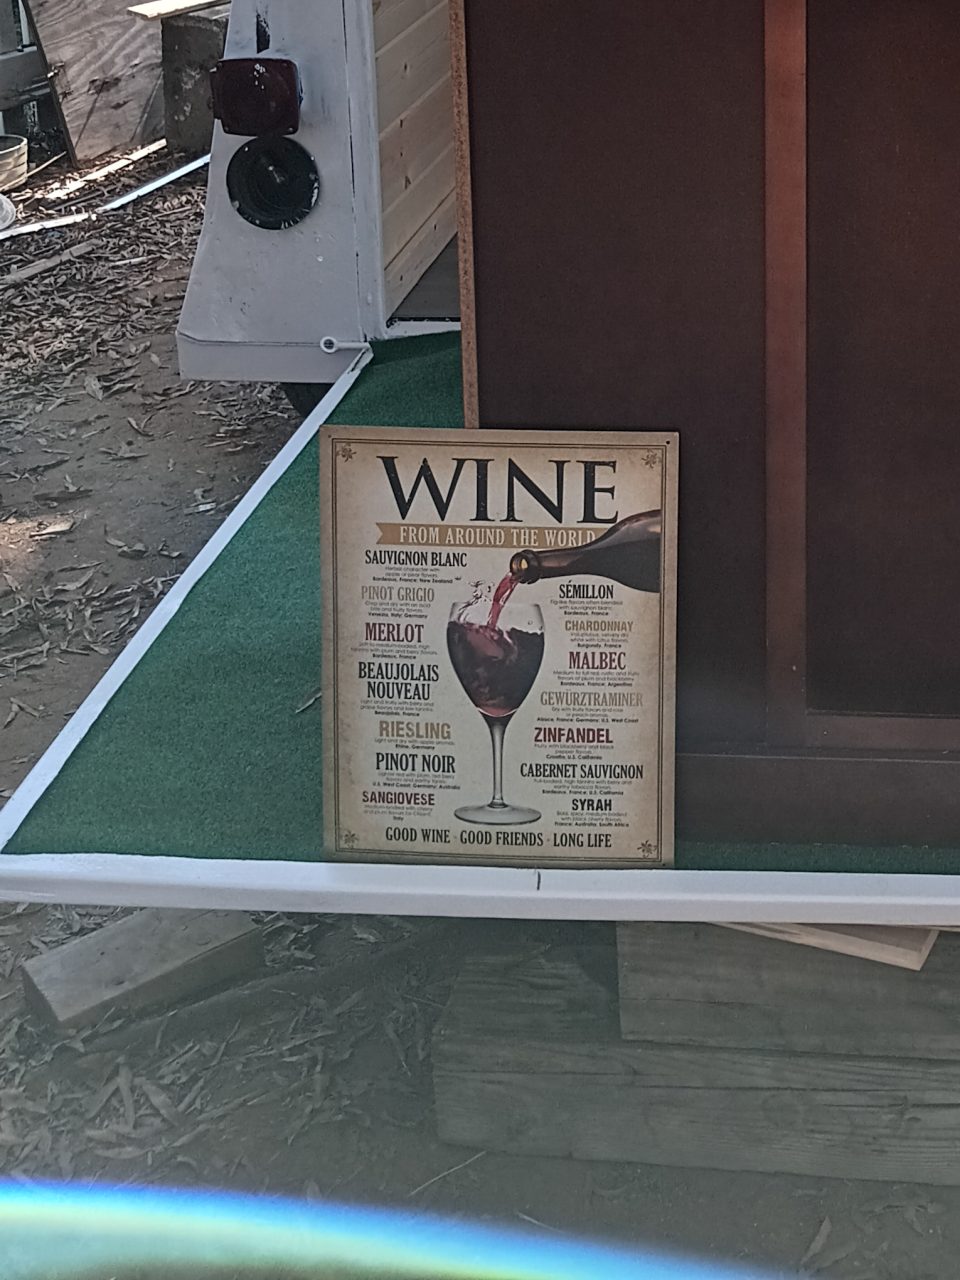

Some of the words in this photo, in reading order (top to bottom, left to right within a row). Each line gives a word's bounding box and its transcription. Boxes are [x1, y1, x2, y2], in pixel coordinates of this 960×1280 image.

[376, 456, 618, 523] WINE
[400, 526, 440, 545] FROM
[445, 527, 505, 546] AROUND
[511, 528, 539, 547] THE
[545, 529, 596, 547] WORLD
[365, 549, 428, 565] SAUVIGNON
[431, 551, 467, 567] BLANC
[361, 586, 394, 600] PINOT
[397, 587, 435, 602] GRIGIO
[559, 579, 614, 598] SÉMILLON
[365, 623, 424, 642] MERLOT
[565, 619, 633, 632] CHARDONNAY
[569, 651, 626, 670] MALBEC
[358, 661, 439, 681] BEAUJOLAIS
[367, 681, 430, 700] NOUVEAU
[540, 689, 643, 706] GEWÜRZTRAMINER
[379, 720, 451, 739] RIESLING
[534, 727, 613, 743] ZINFANDEL
[376, 752, 418, 771] PINOT
[422, 754, 455, 773] NOIR
[520, 763, 577, 778] CABERNET
[580, 764, 643, 779] SAUVIGNON
[362, 791, 435, 806] SANGIOVESE
[572, 798, 612, 811] SYRAH
[385, 826, 418, 842] GOOD
[421, 828, 451, 843] WINE
[460, 830, 492, 845] GOOD
[496, 831, 544, 846] FRIENDS
[553, 832, 584, 848] LONG
[587, 833, 612, 848] LIFE
